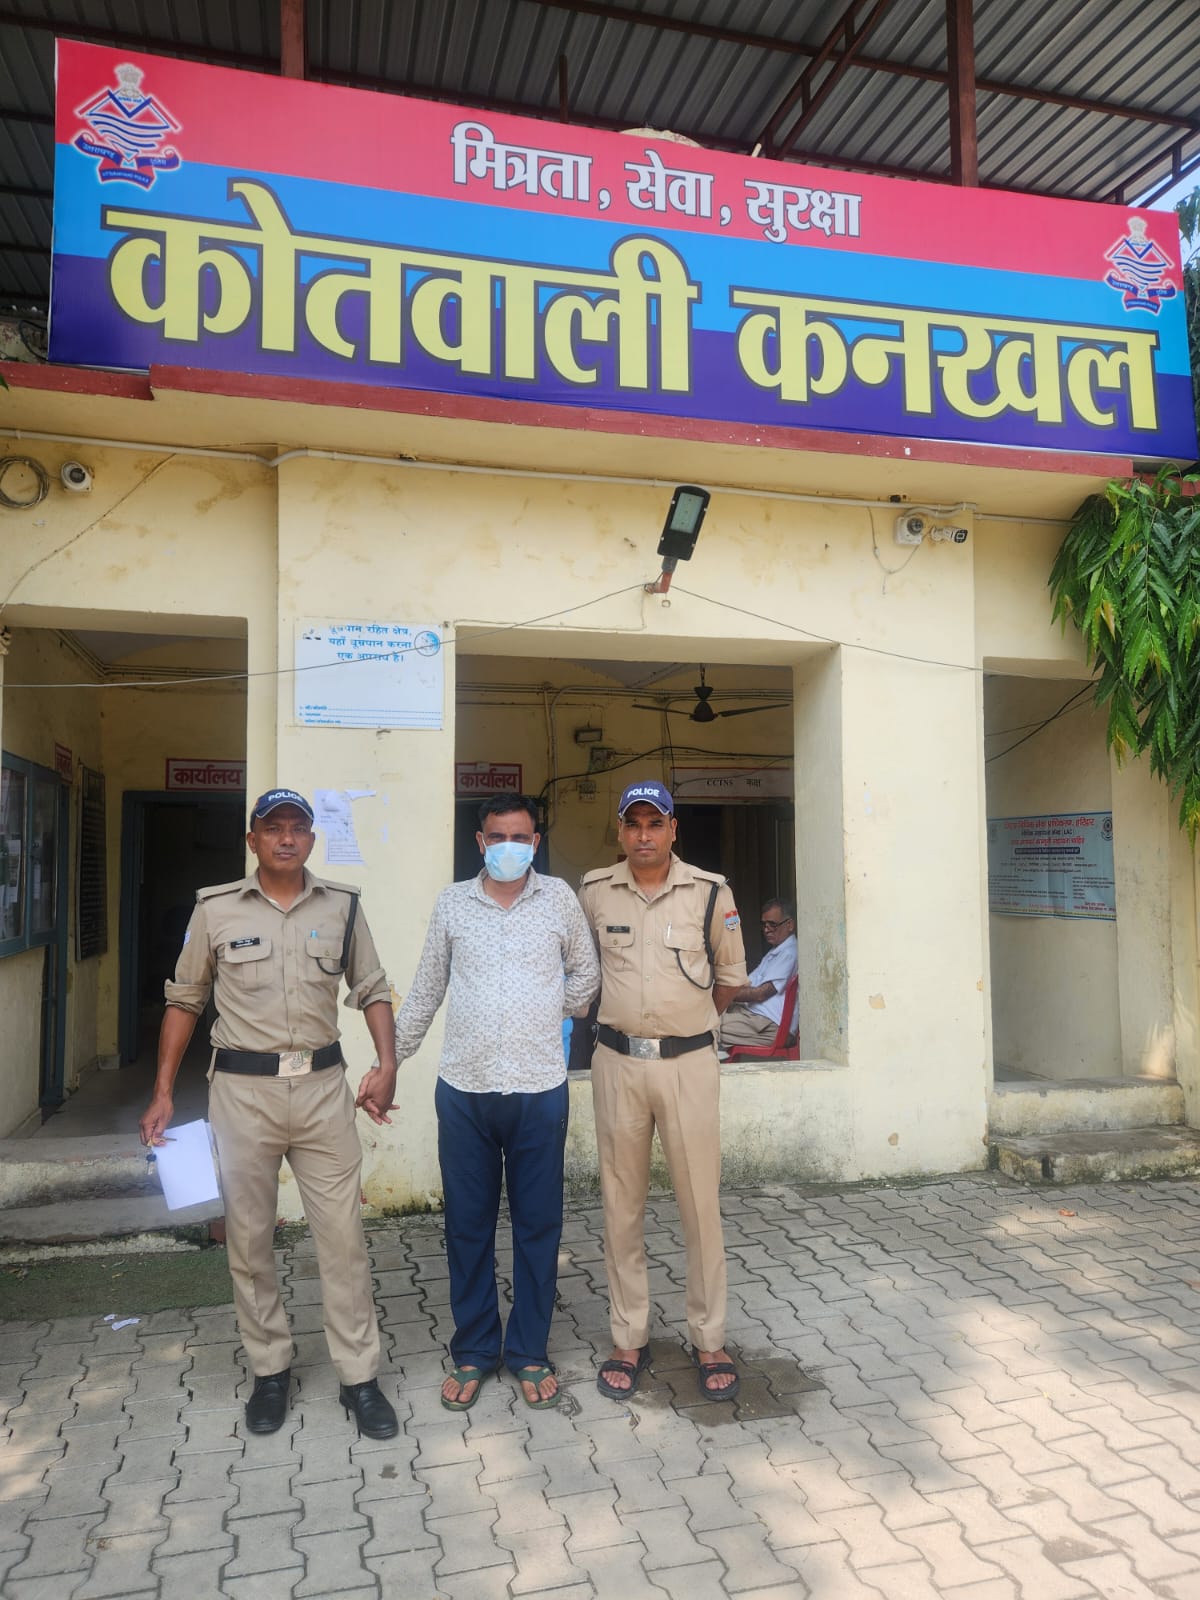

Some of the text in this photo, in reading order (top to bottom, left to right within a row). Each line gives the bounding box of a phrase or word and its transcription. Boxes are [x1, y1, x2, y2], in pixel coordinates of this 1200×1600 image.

[743, 178, 863, 244] सुरक्षा
[102, 177, 1160, 432] कोतवाली कनखल
[387, 640, 412, 649] करना
[336, 652, 353, 661] एक
[173, 764, 244, 785] कार्यालय
[458, 767, 519, 789] कार्यालय
[268, 791, 304, 803] POLICE
[627, 787, 660, 799] POLICE
